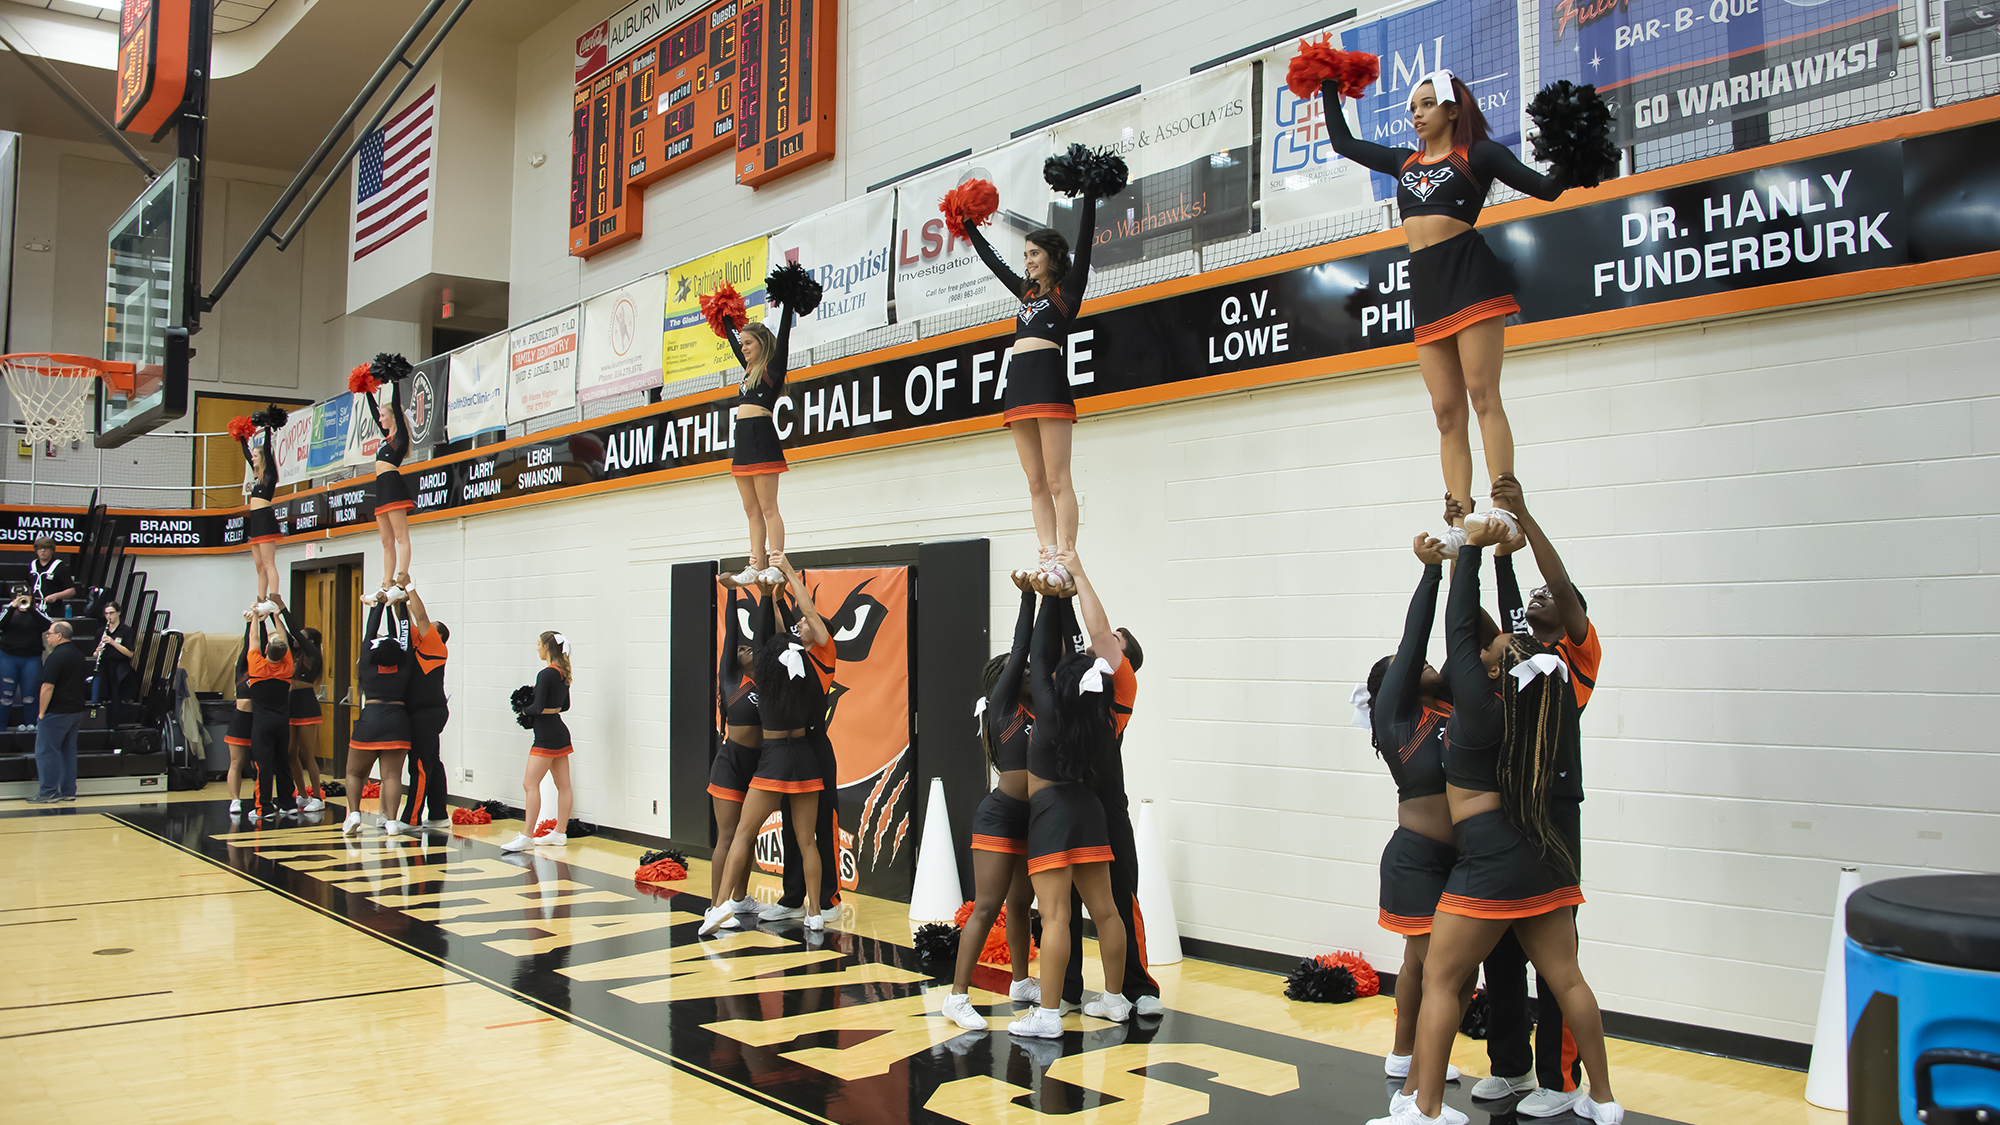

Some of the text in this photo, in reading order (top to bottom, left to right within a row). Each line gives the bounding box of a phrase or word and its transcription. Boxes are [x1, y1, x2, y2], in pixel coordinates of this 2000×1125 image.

[610, 0, 660, 49] AUBURN
[711, 3, 737, 28] Guests
[595, 75, 610, 95] points
[615, 65, 629, 83] fouls
[697, 66, 706, 91] 2
[1635, 38, 1879, 129] GO WARHAWKS!
[669, 80, 692, 107] period
[715, 117, 733, 136] fouls
[1138, 131, 1150, 148] &
[1154, 99, 1244, 143] ASSOCIATES
[668, 138, 690, 160] player
[630, 160, 645, 177] fouls
[1117, 191, 1207, 239] Warhawks!
[1621, 169, 1853, 248] DR. HANLY
[1593, 211, 1893, 297] FUNDERBURK
[724, 256, 752, 284] World
[819, 246, 888, 295] Baptist
[1378, 259, 1411, 295] JE
[816, 291, 867, 321] HEALTH
[1220, 290, 1277, 326] Q.V.
[669, 319, 681, 327] The
[681, 314, 700, 325] Global
[1361, 299, 1414, 337] PHI
[1208, 322, 1289, 364] LOWE
[604, 330, 1095, 472] AUM ATHLEC HALL OF FAE
[527, 447, 553, 468] LEIGH
[419, 472, 447, 491] DAROLD
[469, 460, 495, 481] LARRY
[518, 466, 562, 490] SWANSON
[417, 489, 448, 509] DUNLAVY
[463, 478, 501, 501] CHAPMAN
[300, 500, 315, 515] KATIE
[335, 507, 357, 523] WILSON
[17, 516, 75, 529] MARTIN
[139, 519, 192, 532] BRANDI
[225, 516, 244, 531] JUNIOR
[296, 514, 318, 530] BARNETT
[0, 528, 84, 543] GUSTAVSSO
[130, 531, 200, 545] RICHARDS
[224, 529, 244, 543] KELLEY
